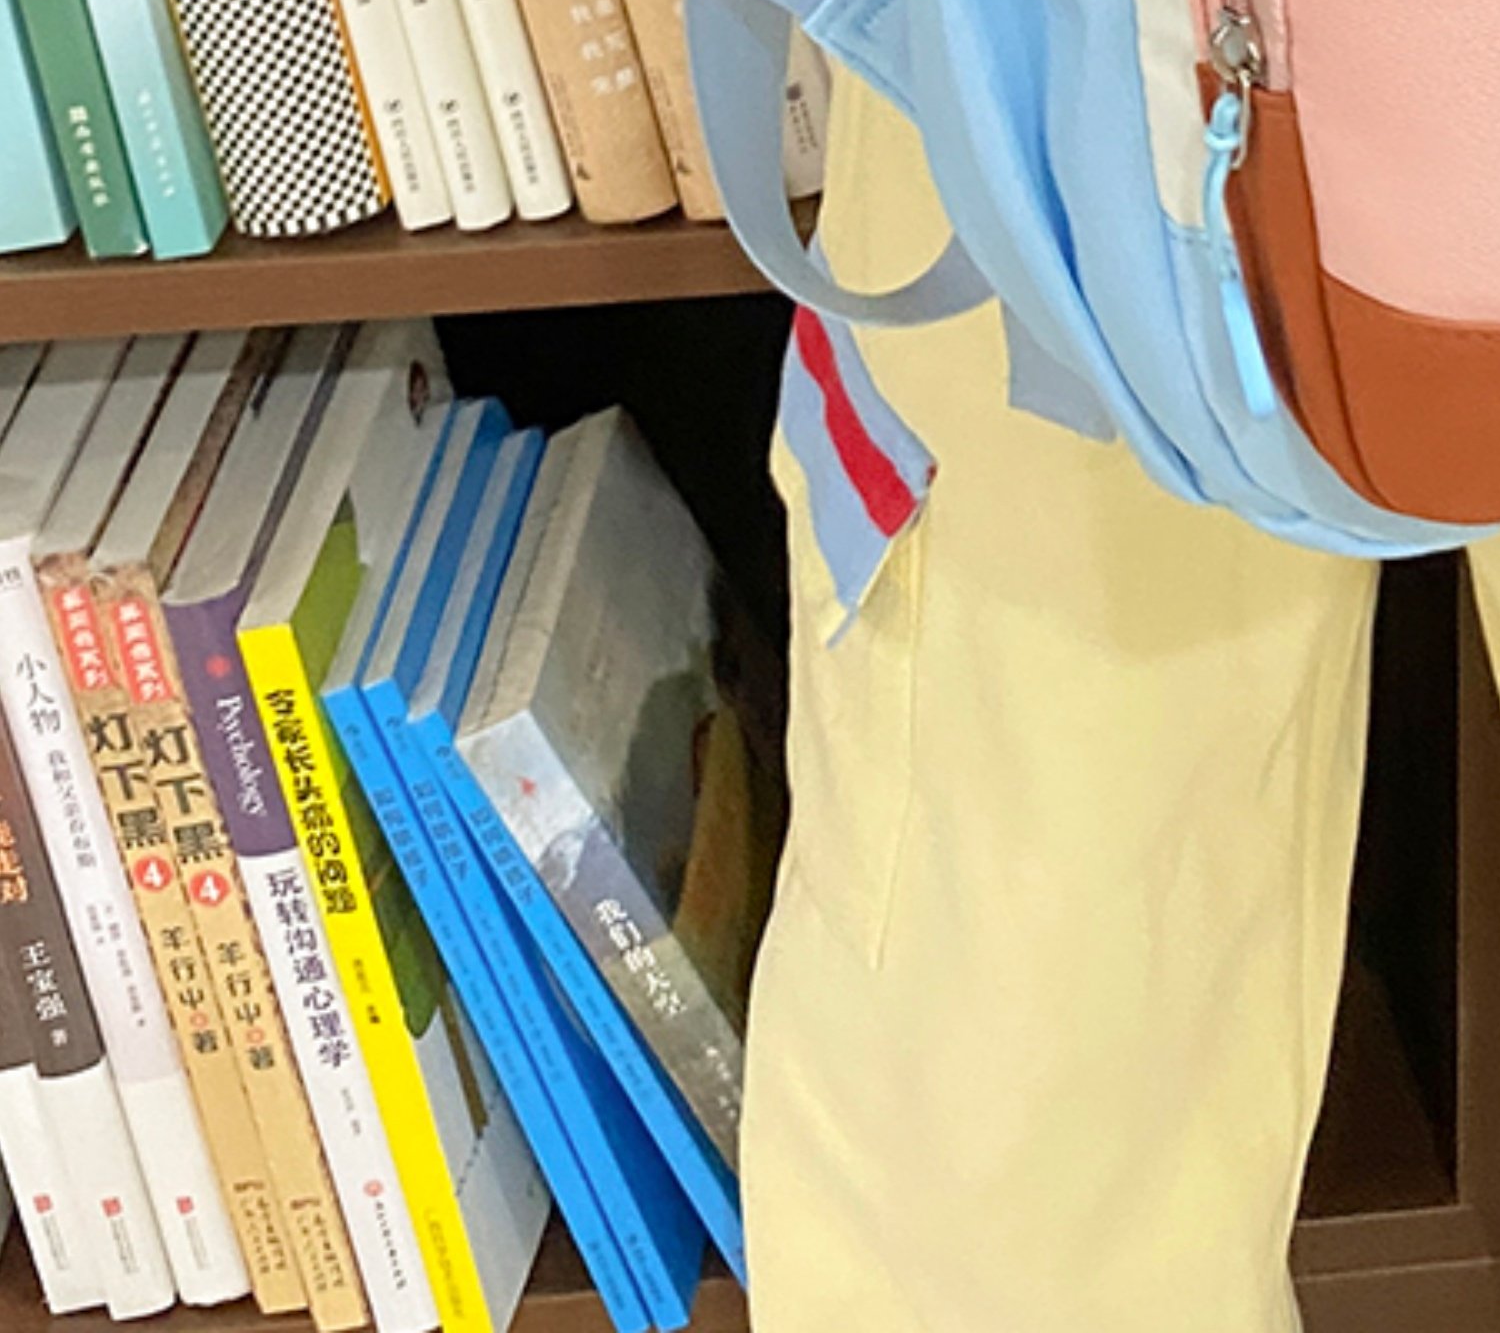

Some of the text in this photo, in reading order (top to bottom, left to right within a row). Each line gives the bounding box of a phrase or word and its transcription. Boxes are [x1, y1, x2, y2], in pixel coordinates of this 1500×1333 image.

[16, 653, 62, 735] 小人物
[217, 693, 267, 816] Psychology
[88, 713, 166, 848] 灯下黑
[143, 723, 224, 866] 灯下黑
[265, 868, 352, 1070] 玩转沟通心理学
